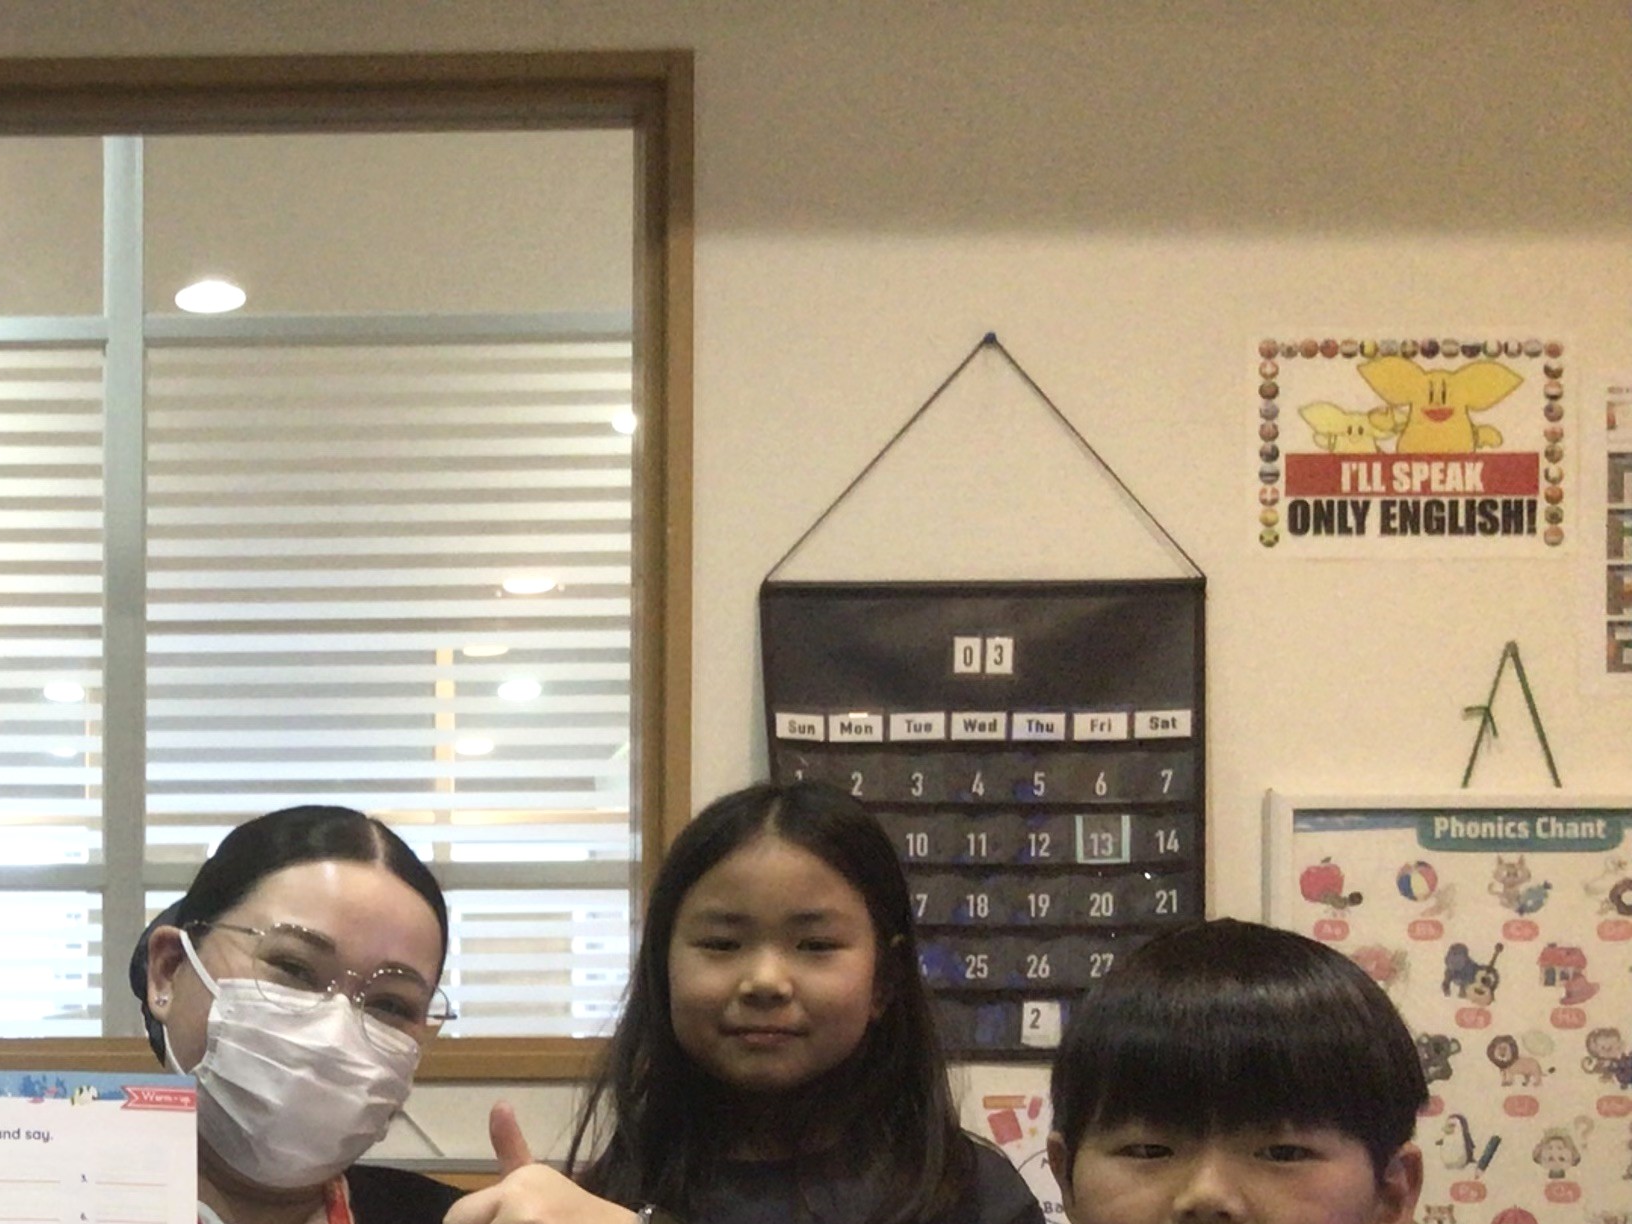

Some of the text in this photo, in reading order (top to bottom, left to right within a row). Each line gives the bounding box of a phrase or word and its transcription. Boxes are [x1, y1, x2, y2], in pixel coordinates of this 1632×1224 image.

[1340, 461, 1484, 493] I'LL SPEAK
[1287, 498, 1537, 536] ONLY ENGLISH!
[788, 715, 1178, 736] Sun Mon Tue Wed Thu Fri Sat
[850, 769, 1173, 796] 2 3 4 5 6 7
[1434, 816, 1606, 839] Phonics Chant
[905, 830, 1180, 858] 10 11 12 13 14
[966, 890, 1178, 918] 18 19 20 21
[964, 953, 1114, 980] 25 26 27
[1029, 1008, 1041, 1030] 2
[25, 1131, 54, 1143] say.
